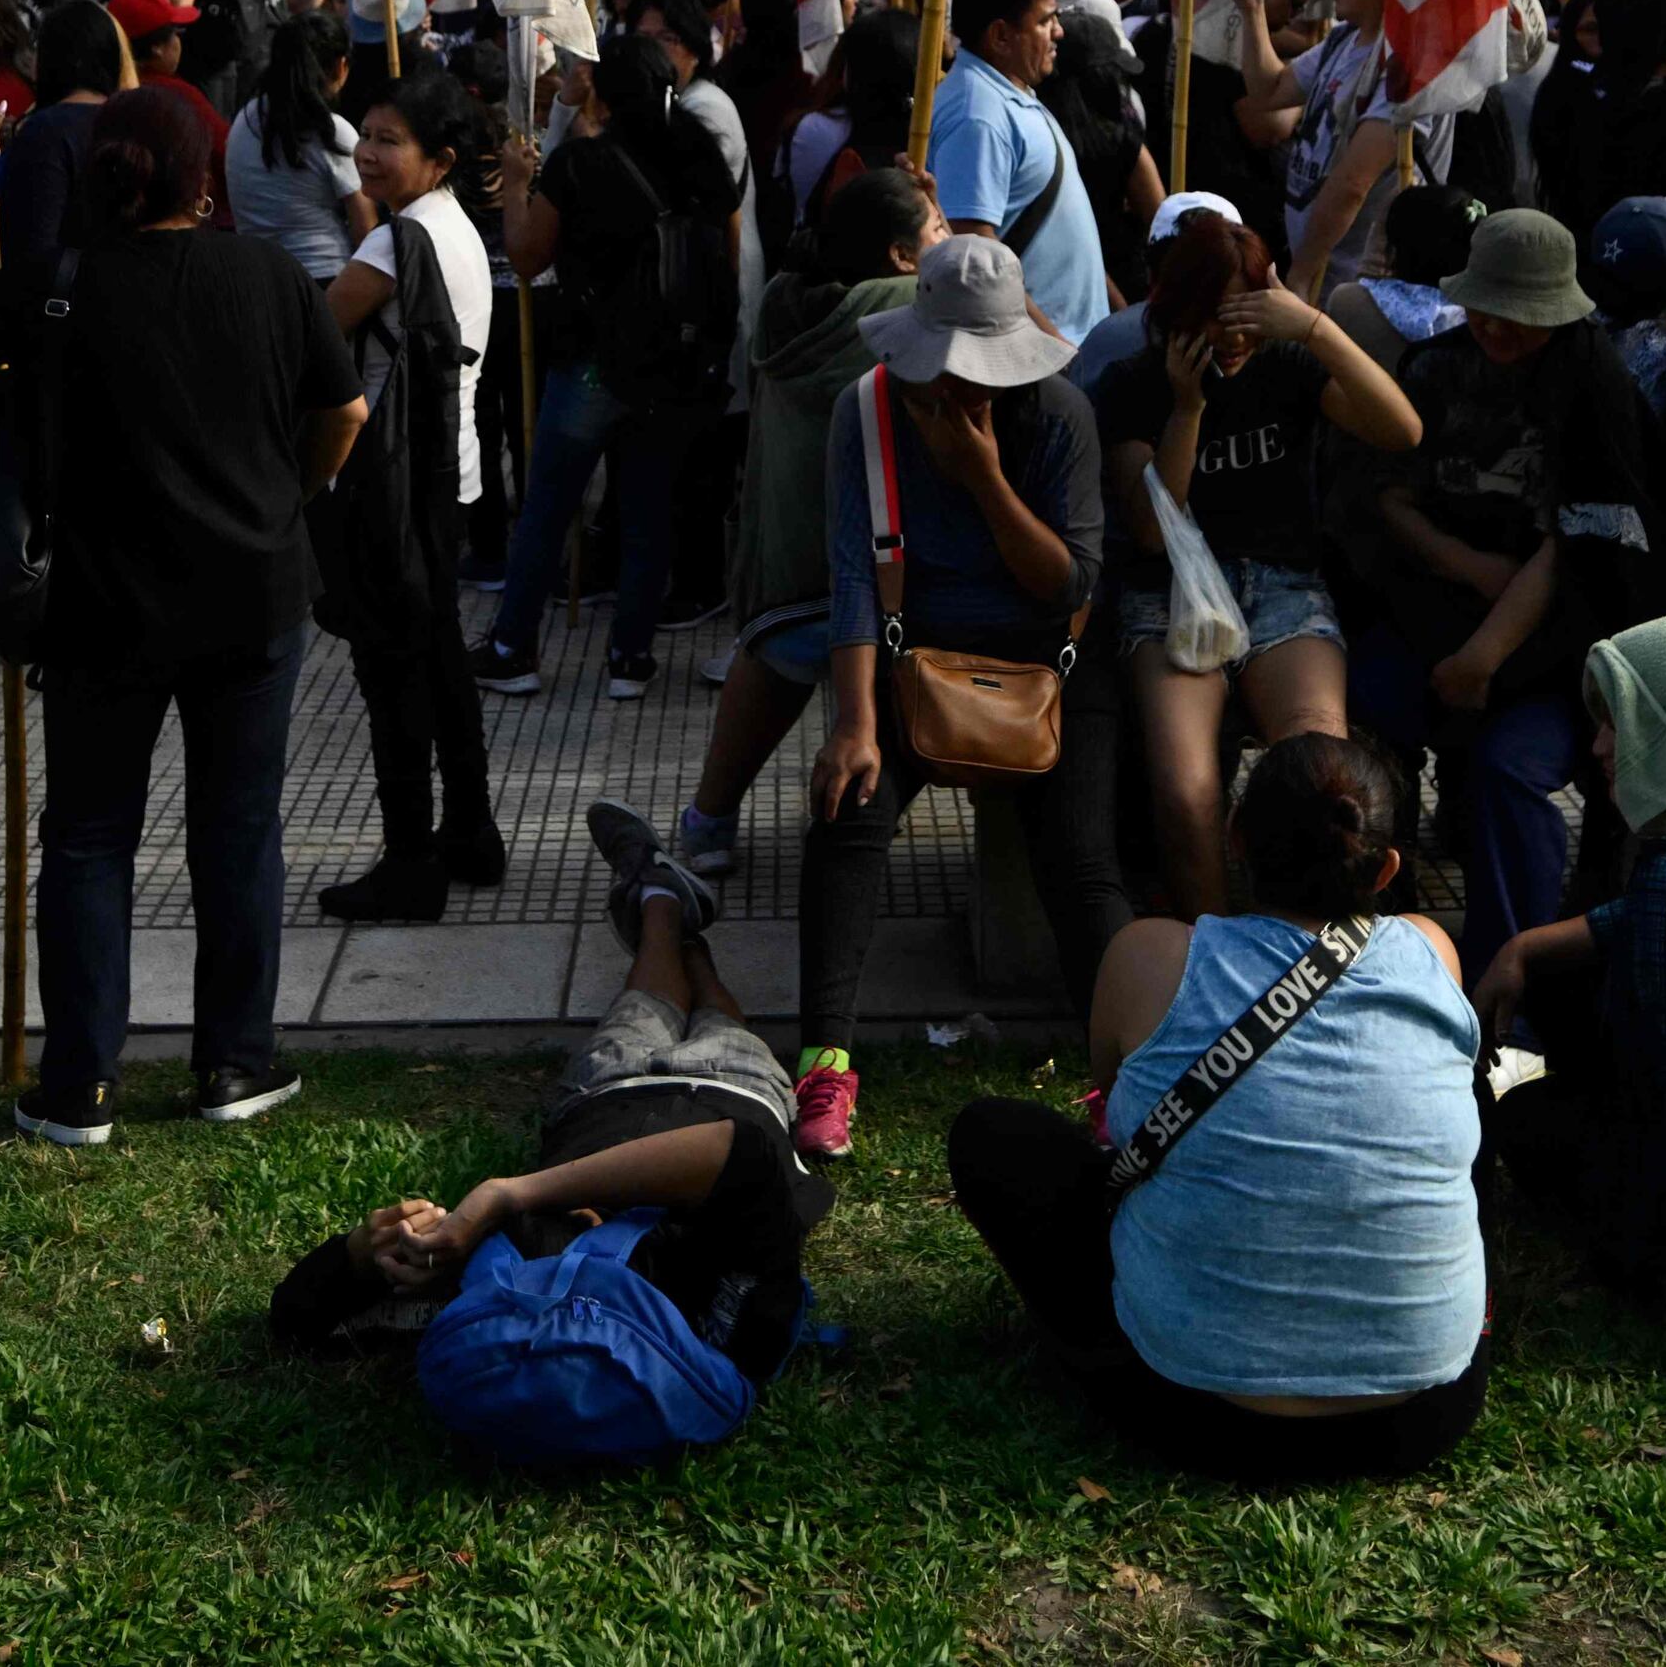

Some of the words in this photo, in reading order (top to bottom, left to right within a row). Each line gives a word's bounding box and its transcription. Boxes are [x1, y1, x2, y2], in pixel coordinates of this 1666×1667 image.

[1144, 1088, 1194, 1148] SEE
[1188, 1024, 1254, 1093] YOU
[1253, 954, 1329, 1033] LOVE
